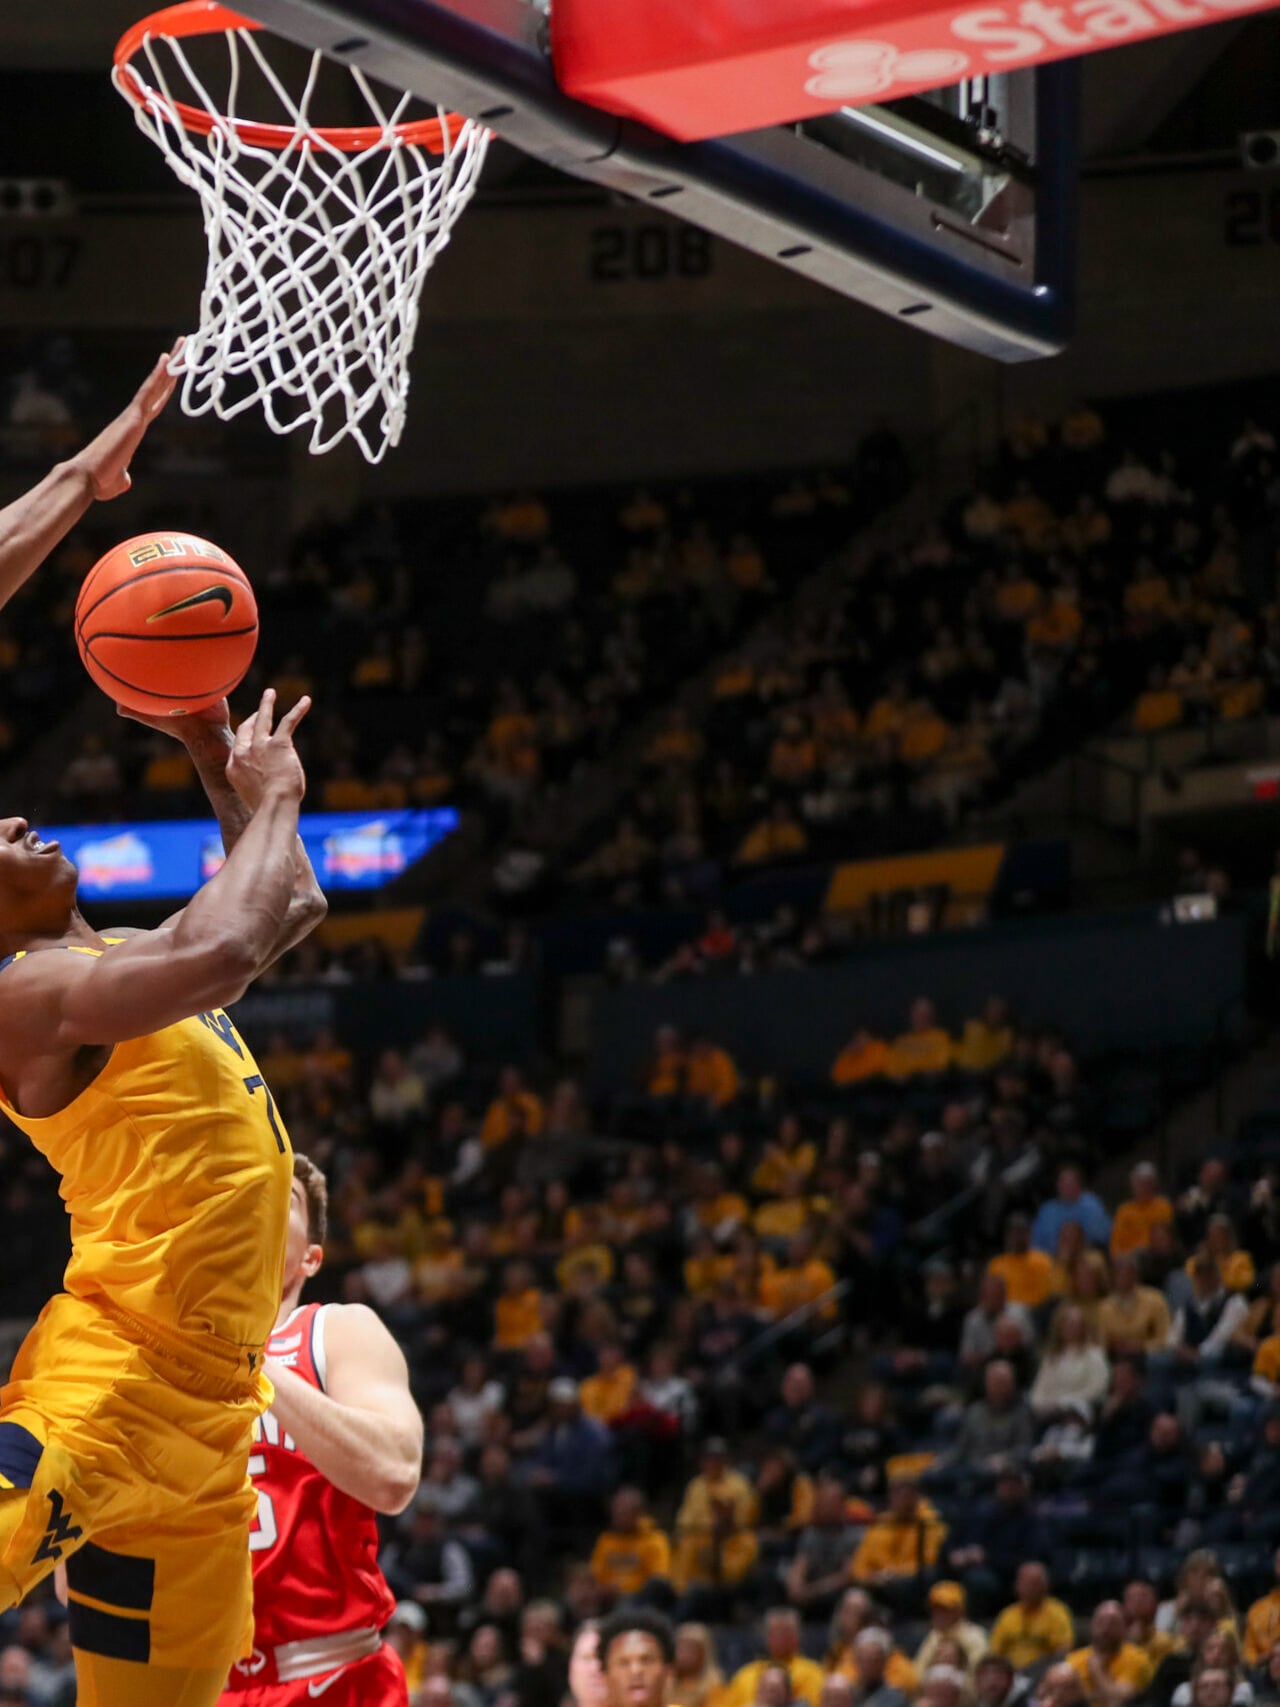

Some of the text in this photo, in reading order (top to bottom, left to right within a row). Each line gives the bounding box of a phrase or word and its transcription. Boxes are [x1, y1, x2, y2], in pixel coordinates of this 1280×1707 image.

[950, 0, 1270, 62] Sta
[591, 226, 710, 279] 208
[243, 1074, 286, 1154] 7
